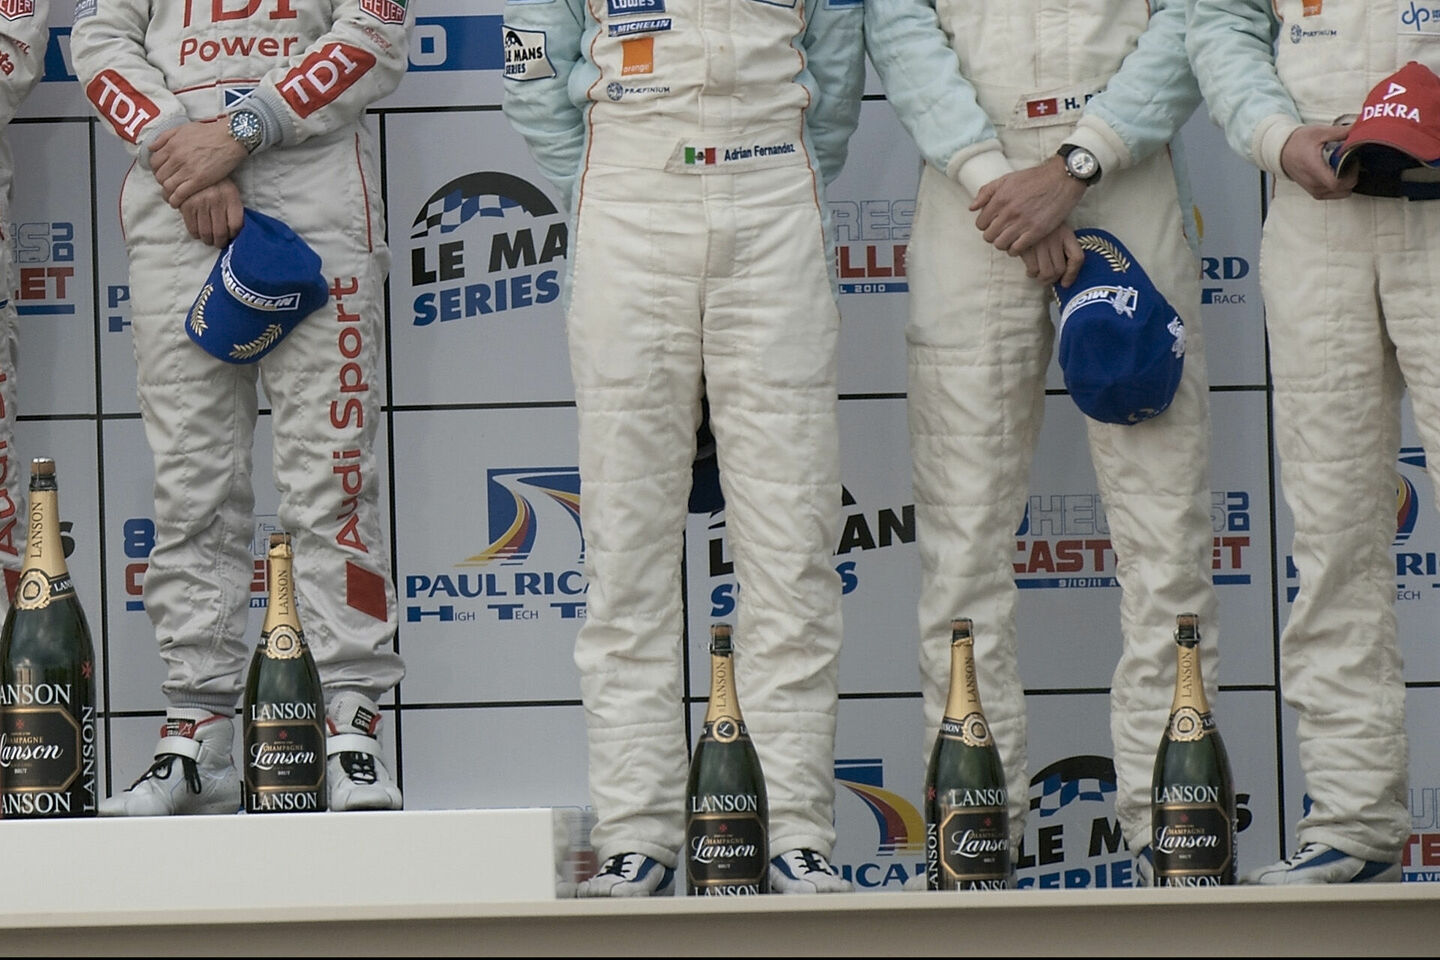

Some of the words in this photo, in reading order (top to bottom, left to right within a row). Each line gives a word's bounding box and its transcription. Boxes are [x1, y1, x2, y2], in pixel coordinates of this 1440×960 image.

[617, 19, 669, 32] MICHELIN
[179, 37, 299, 67] Power
[282, 45, 358, 105] TDI
[98, 76, 150, 137] TDI
[1362, 102, 1421, 124] DEKRA
[724, 147, 752, 161] Adrian
[754, 143, 795, 159] Fernandez
[411, 249, 464, 287] LE
[225, 270, 295, 307] MICHELIN
[413, 269, 560, 326] SERIES
[329, 277, 370, 429] Sport
[332, 450, 368, 554] Audi
[31, 502, 44, 558] LANSON
[278, 569, 288, 617] LANSON
[406, 574, 510, 598] PAUL
[716, 662, 726, 709] LANSON
[967, 656, 978, 703] LANSON
[1182, 651, 1190, 698] LANSON
[251, 703, 317, 721] LANSON
[81, 705, 95, 812] LANSON
[250, 742, 317, 770] Lanson
[252, 792, 318, 811] LANSON
[692, 794, 757, 813] LANSON
[1155, 786, 1219, 803] LANSON
[691, 835, 757, 864] Lanson
[1155, 827, 1220, 854] Lanson
